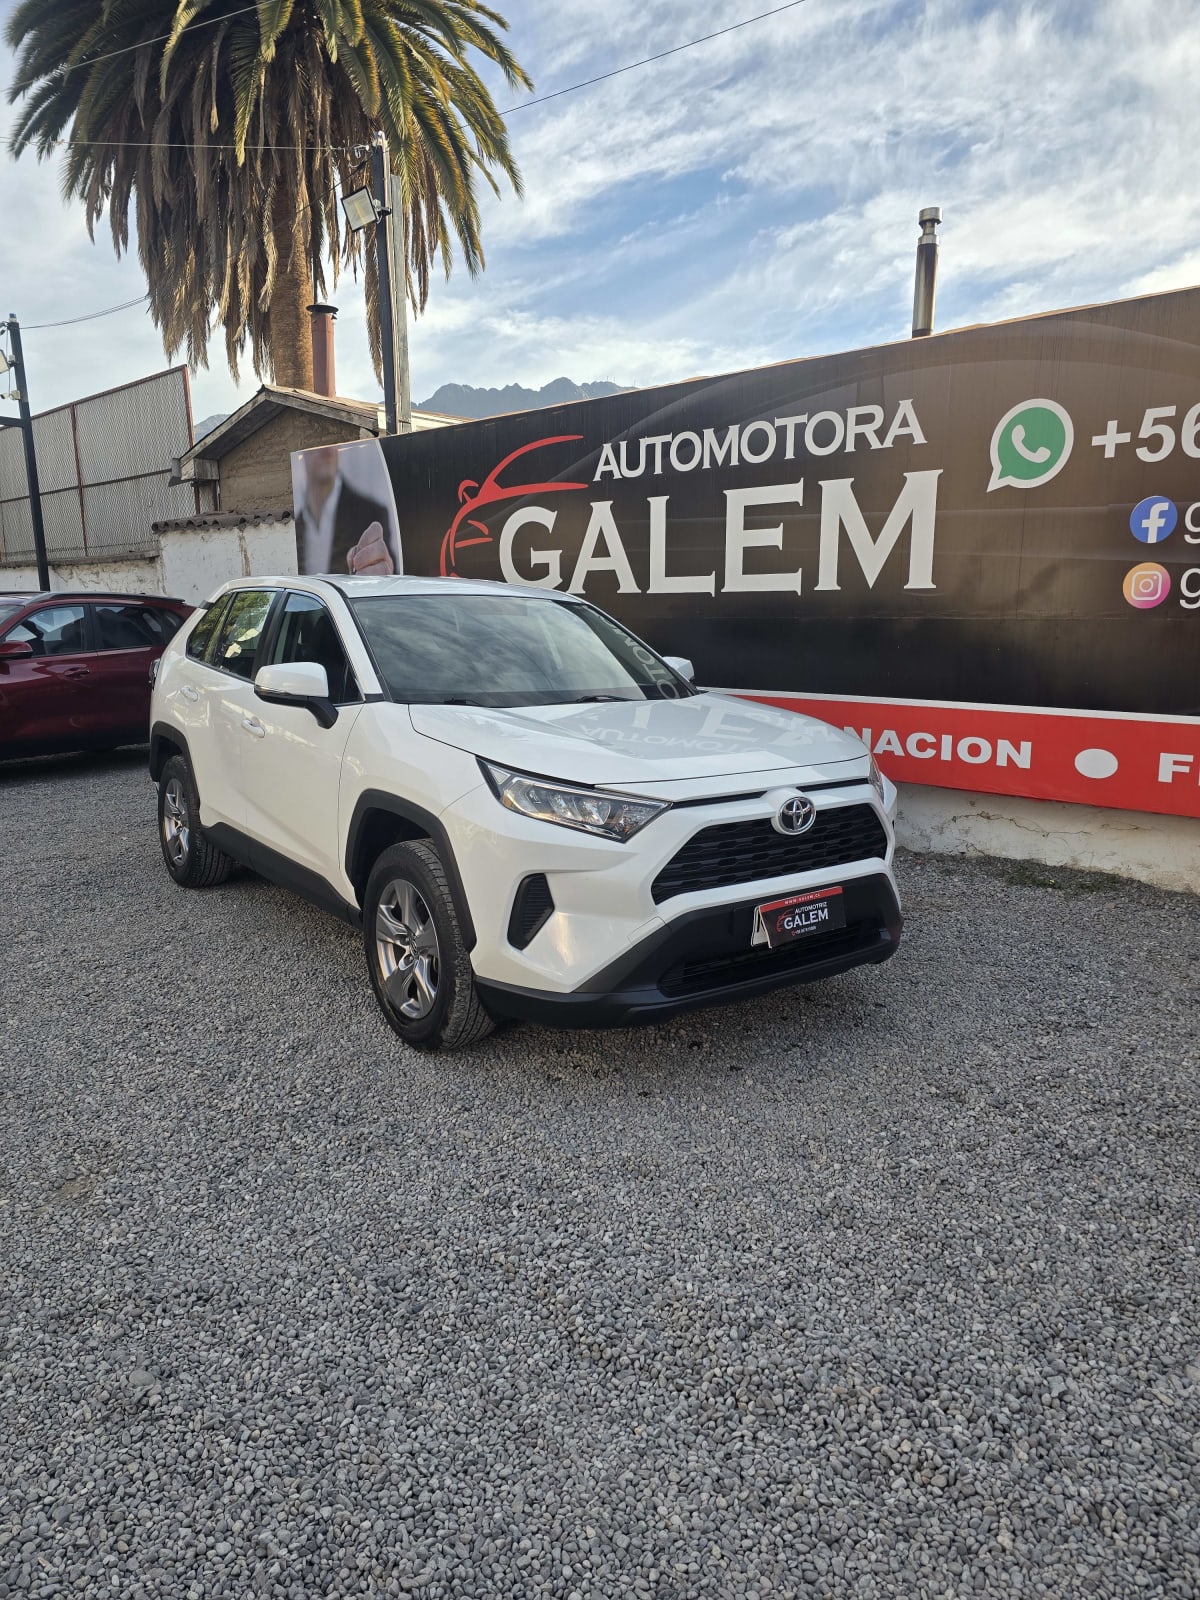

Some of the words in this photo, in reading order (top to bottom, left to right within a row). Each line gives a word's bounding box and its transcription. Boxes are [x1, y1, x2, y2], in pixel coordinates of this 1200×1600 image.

[593, 399, 928, 482] AUTOMOTORA
[499, 469, 944, 597] GALEM
[1157, 752, 1200, 784] F
[783, 908, 829, 930] GALEM
